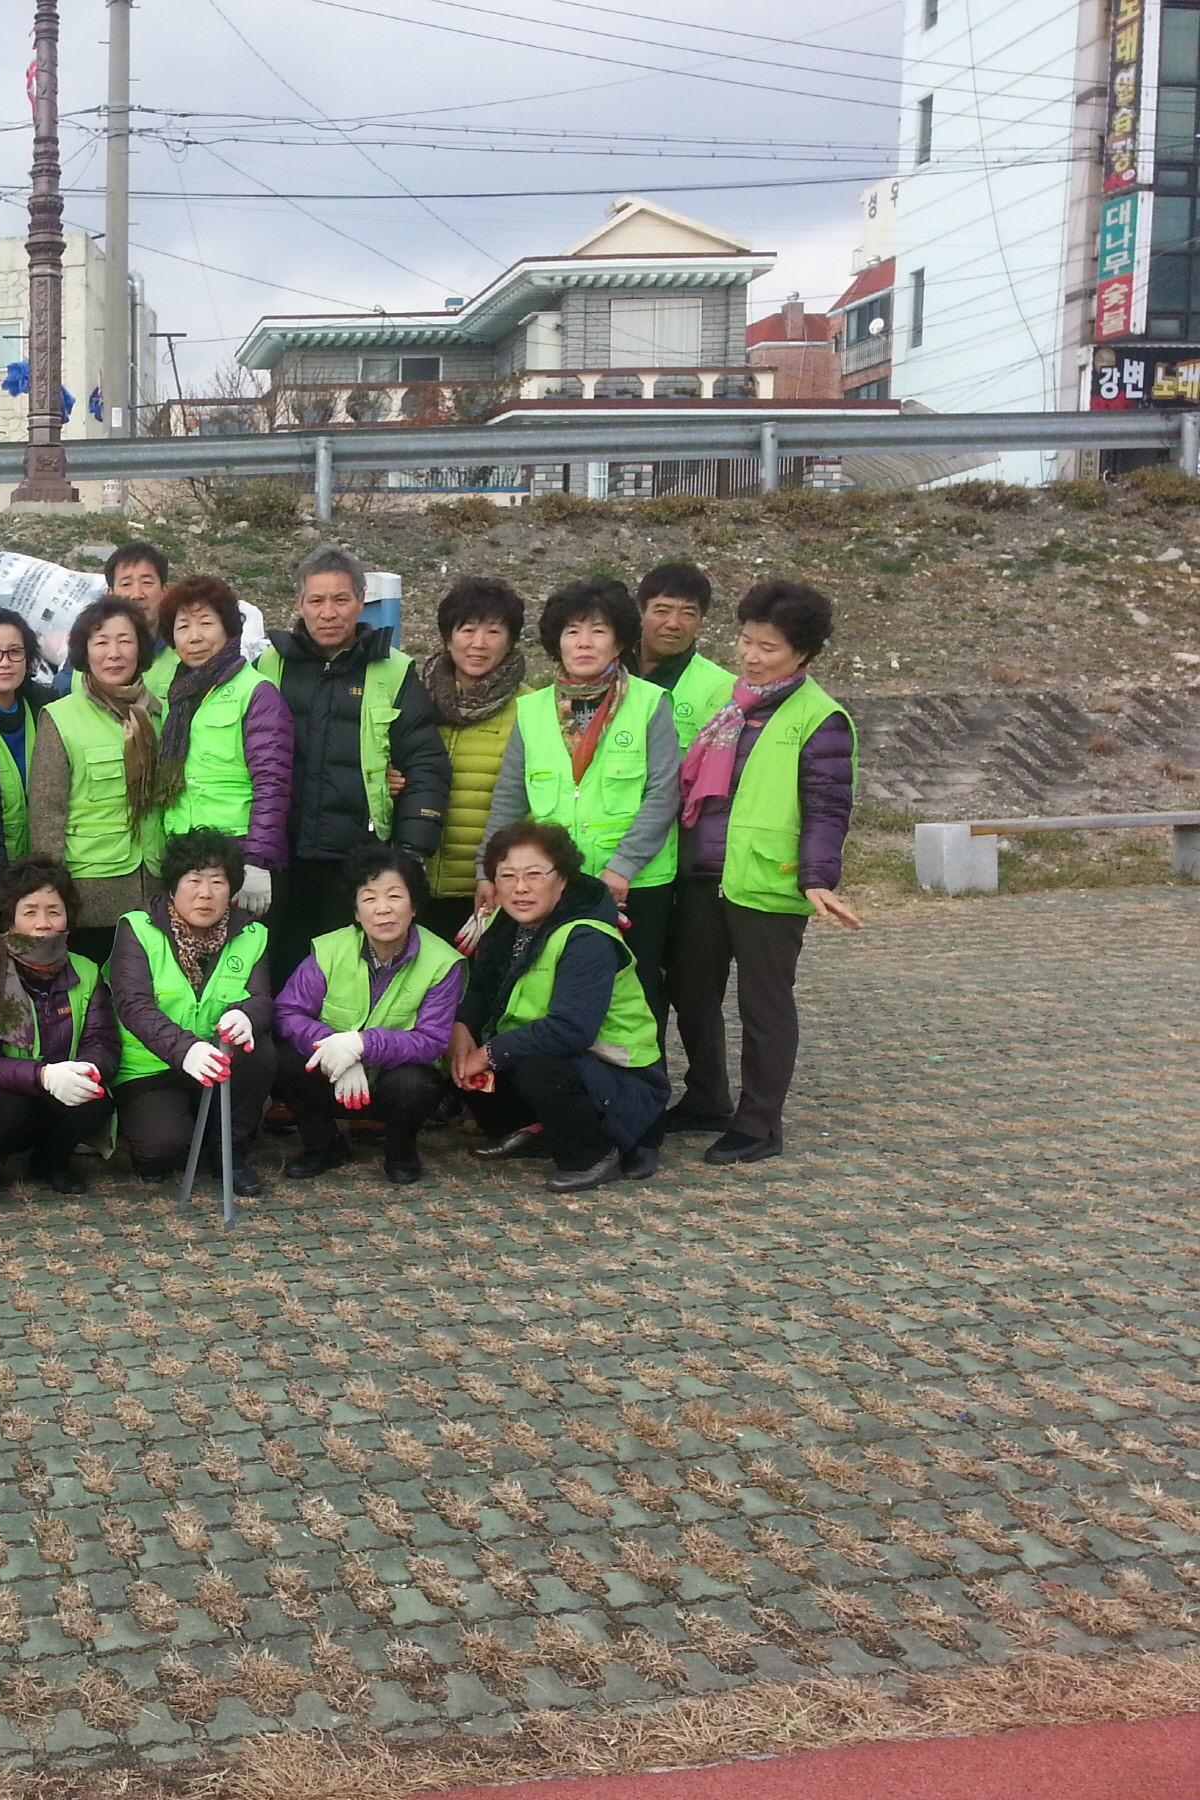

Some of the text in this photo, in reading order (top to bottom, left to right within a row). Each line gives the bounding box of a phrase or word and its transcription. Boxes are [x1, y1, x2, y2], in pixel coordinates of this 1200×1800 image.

[1103, 199, 1132, 275] 대나무
[1101, 283, 1129, 335] 숯불
[1099, 358, 1145, 399] 강변
